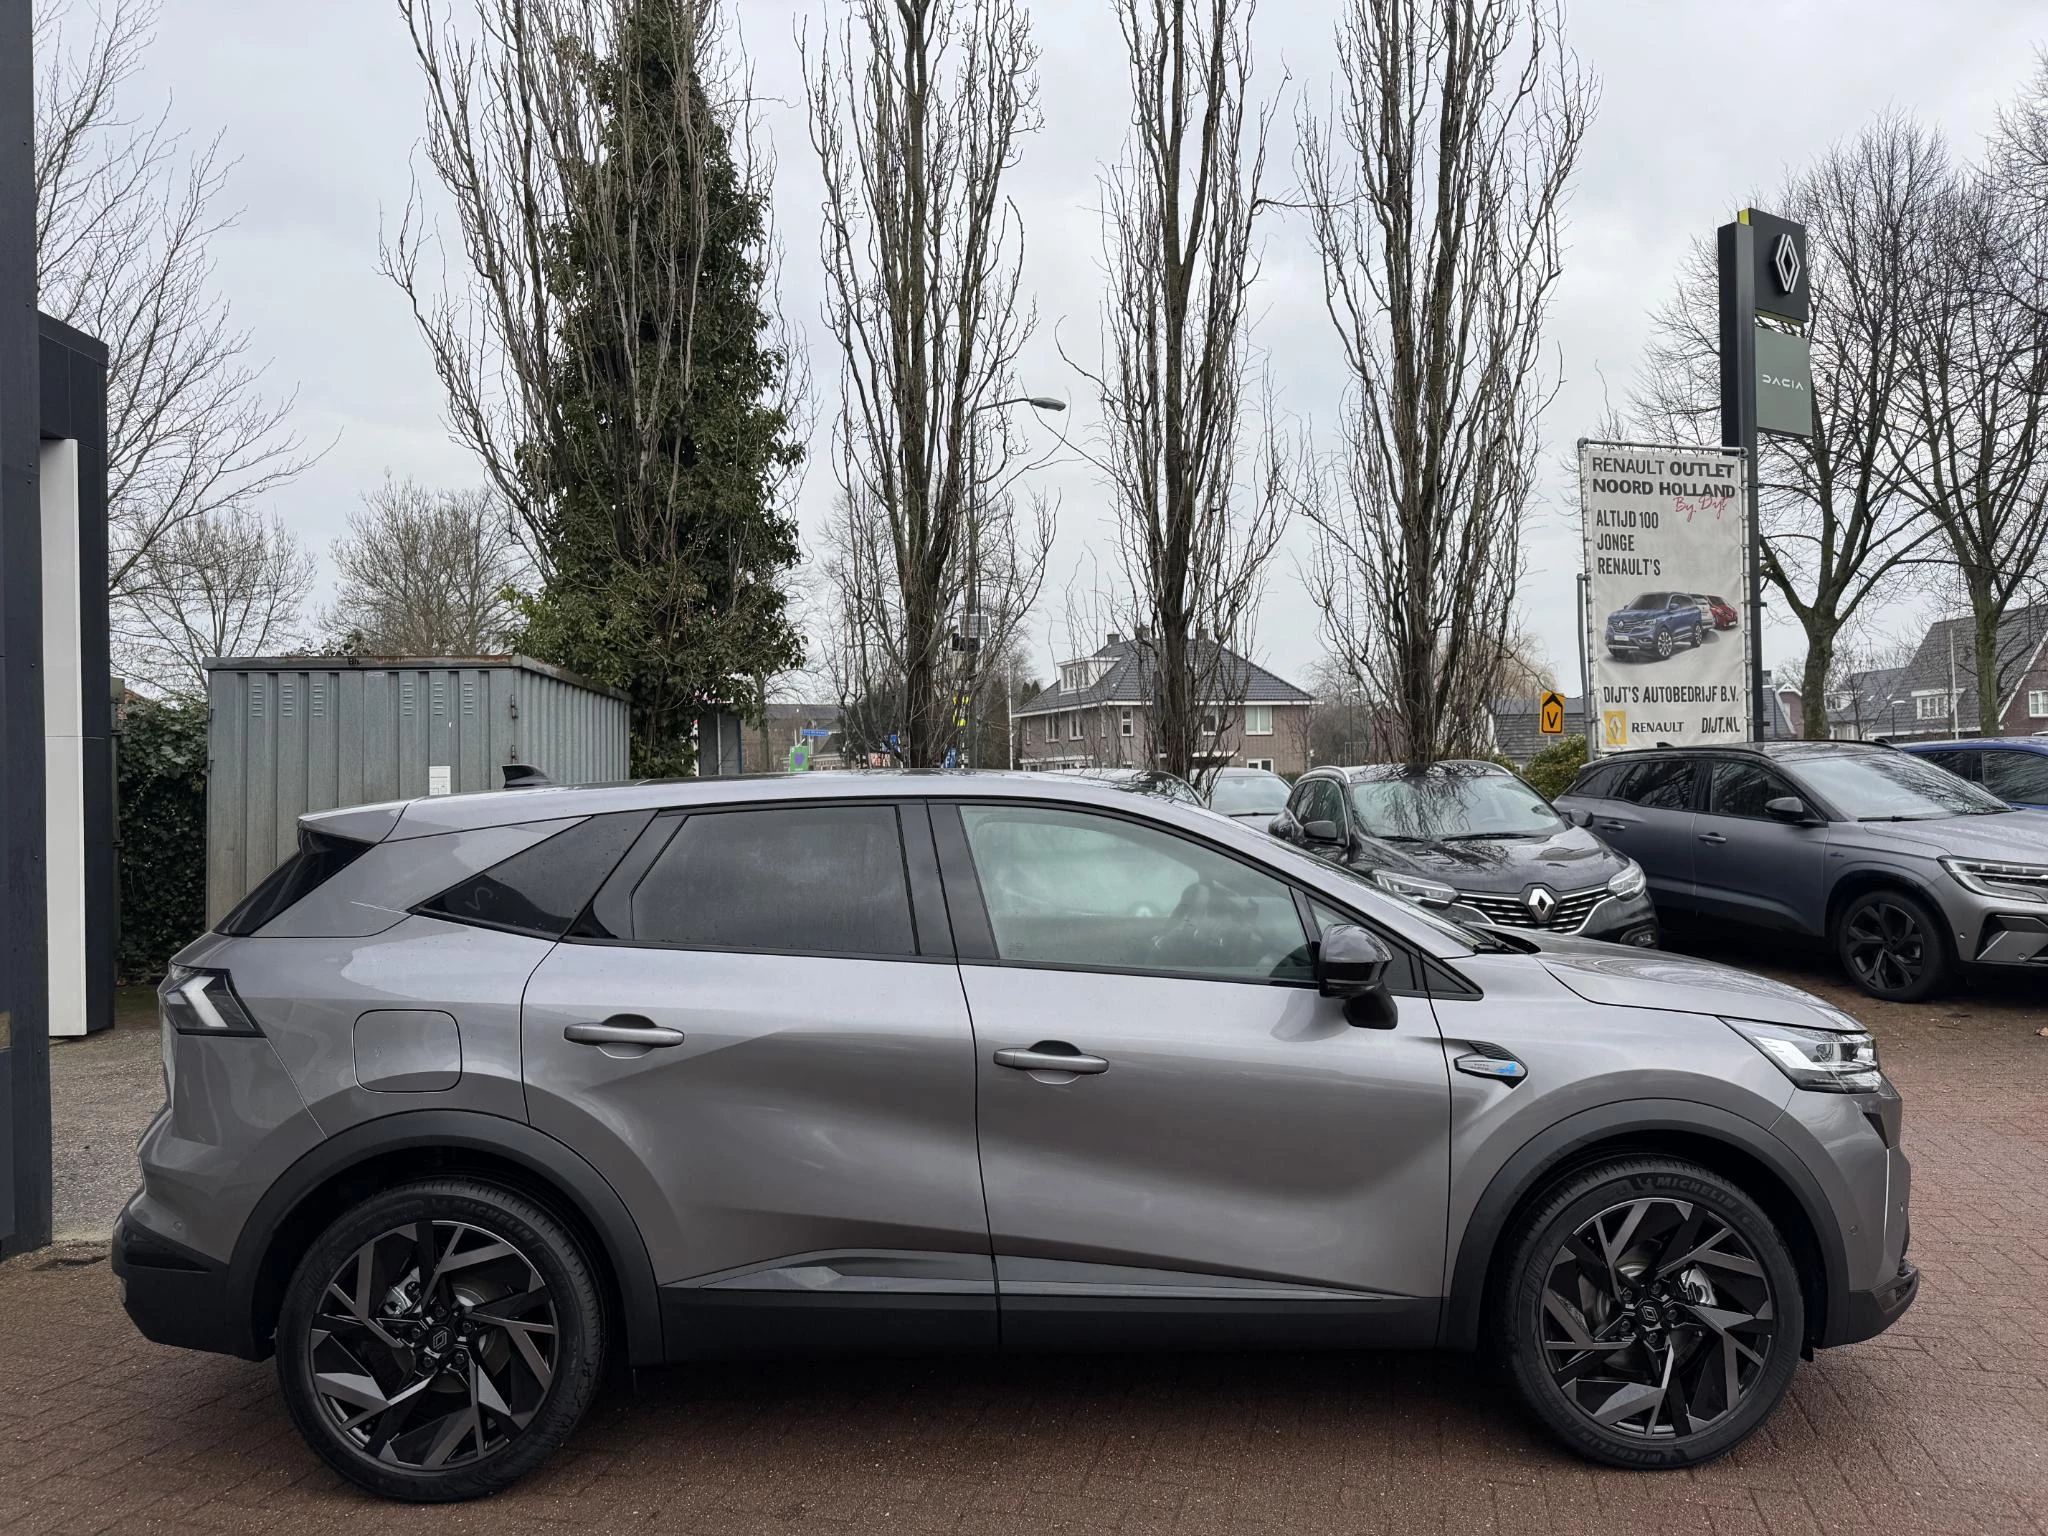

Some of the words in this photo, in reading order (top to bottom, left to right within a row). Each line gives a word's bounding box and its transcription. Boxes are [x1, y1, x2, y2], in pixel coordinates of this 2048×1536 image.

[1762, 374, 1803, 391] DACIA
[1592, 457, 1664, 475] RENAULT
[1669, 461, 1735, 479] OUTLET
[1592, 478, 1653, 495] NOORD
[1659, 482, 1735, 499] HOLLAND
[1596, 510, 1637, 529] ALTIJD
[1639, 512, 1659, 529] 100
[1597, 533, 1635, 551] JONGE
[1597, 557, 1661, 576] RENAULT'S
[1603, 686, 1639, 703] DIJT'S
[1643, 687, 1717, 703] AUTOBEDRIJF
[1720, 686, 1739, 702] B.V.
[1631, 721, 1685, 733] RENAULT
[1701, 716, 1740, 734] DIJT.NL
[1655, 1175, 1738, 1210] MICHELIN
